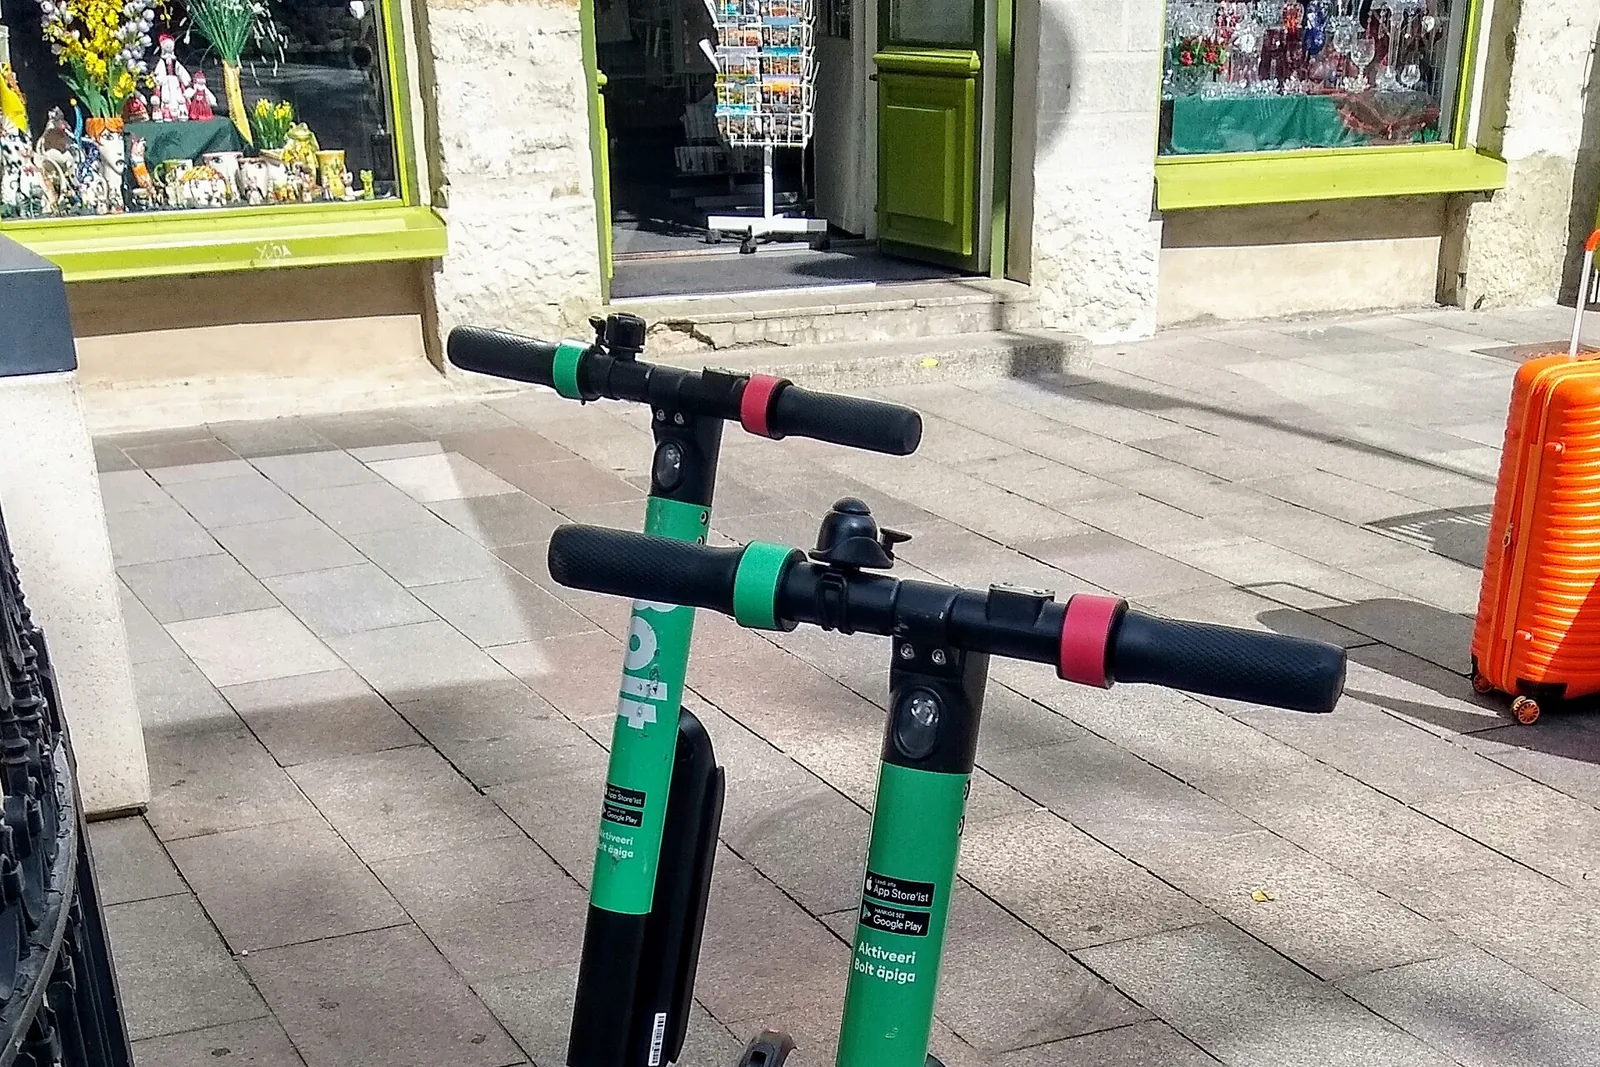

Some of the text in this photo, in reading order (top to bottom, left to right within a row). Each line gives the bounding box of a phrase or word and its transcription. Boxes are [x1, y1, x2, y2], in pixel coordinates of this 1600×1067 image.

[616, 600, 668, 730] olt
[606, 811, 638, 825] Google Play
[873, 884, 890, 898] App
[873, 914, 922, 933] Google Play
[858, 941, 916, 964] Aktiveeri
[854, 957, 916, 985] Bolt äpiga
